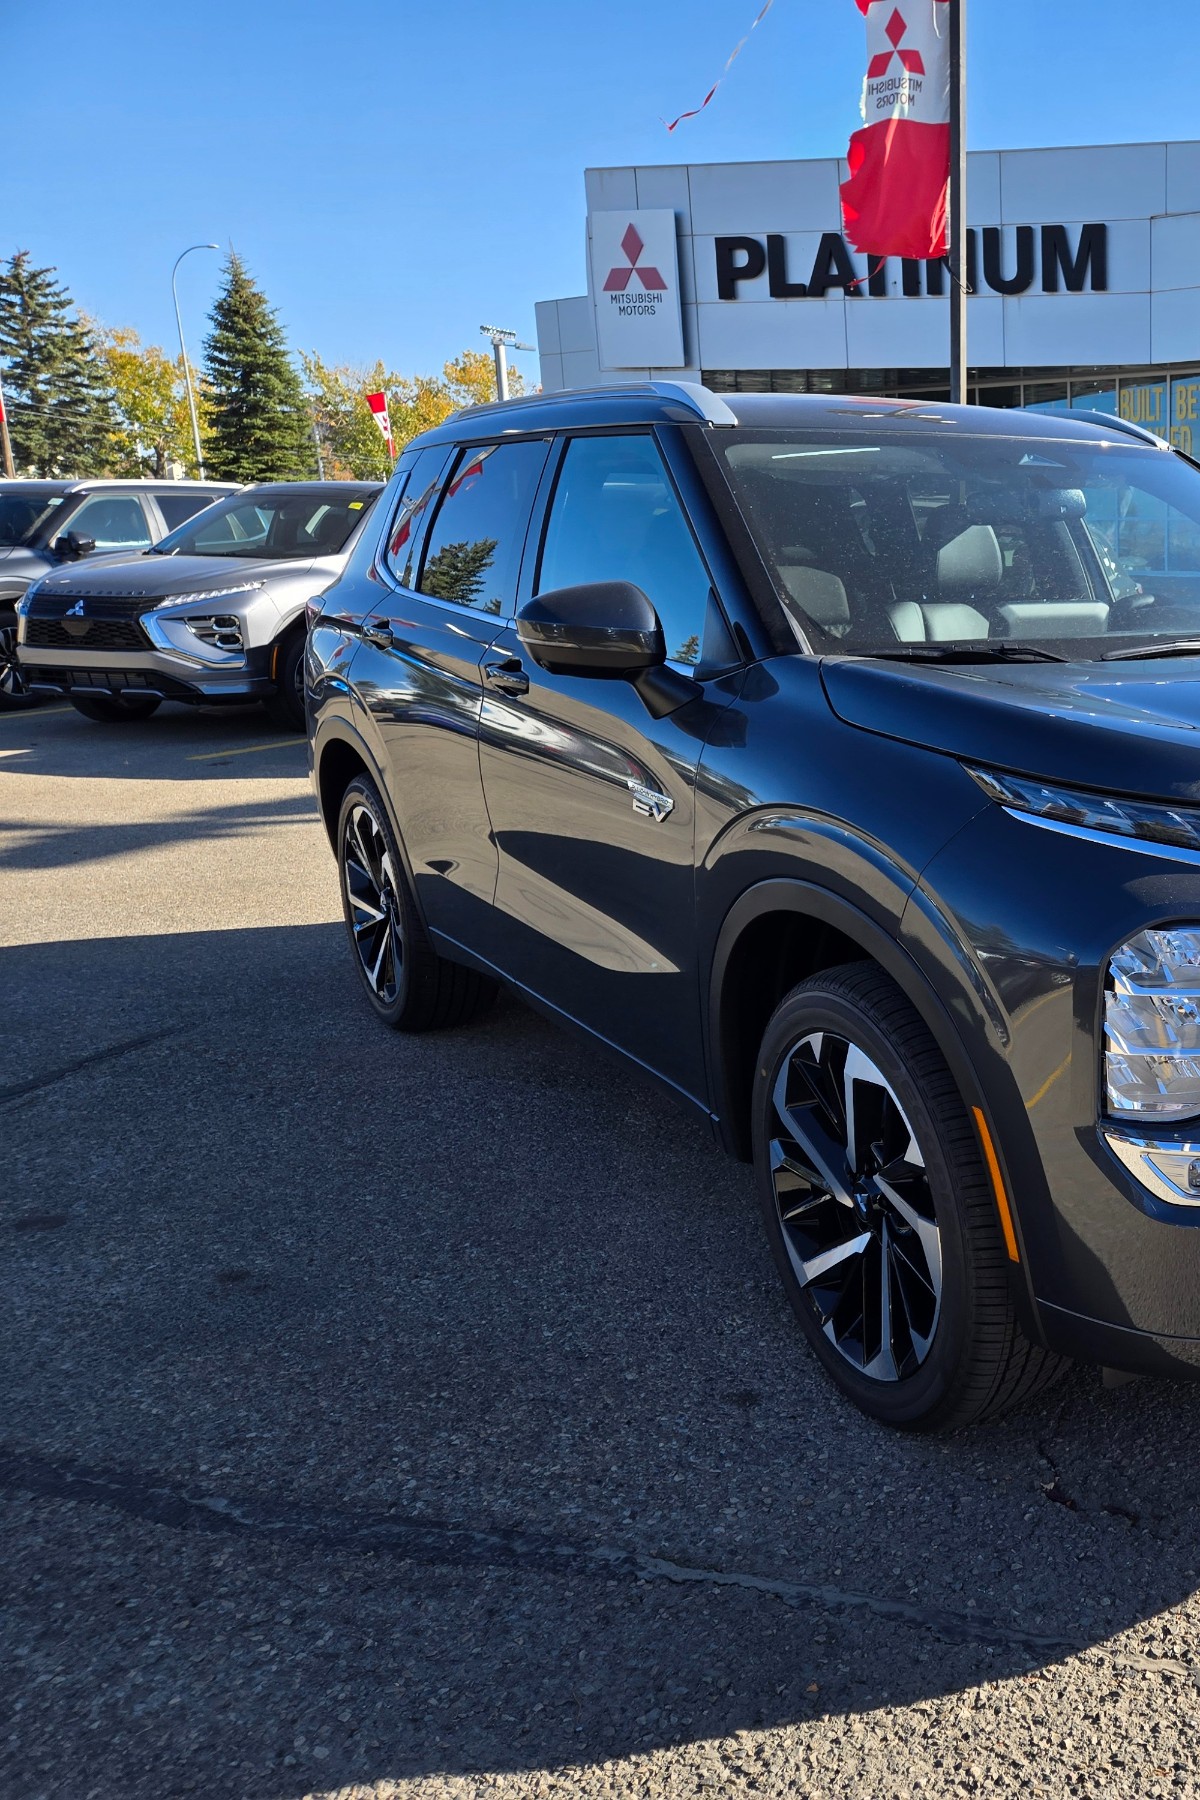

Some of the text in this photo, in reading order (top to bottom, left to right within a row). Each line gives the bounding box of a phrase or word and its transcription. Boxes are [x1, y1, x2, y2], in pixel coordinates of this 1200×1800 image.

[610, 293, 663, 304] MITSUBISHI
[618, 305, 656, 316] MOTORS
[1120, 387, 1163, 423] BUILT
